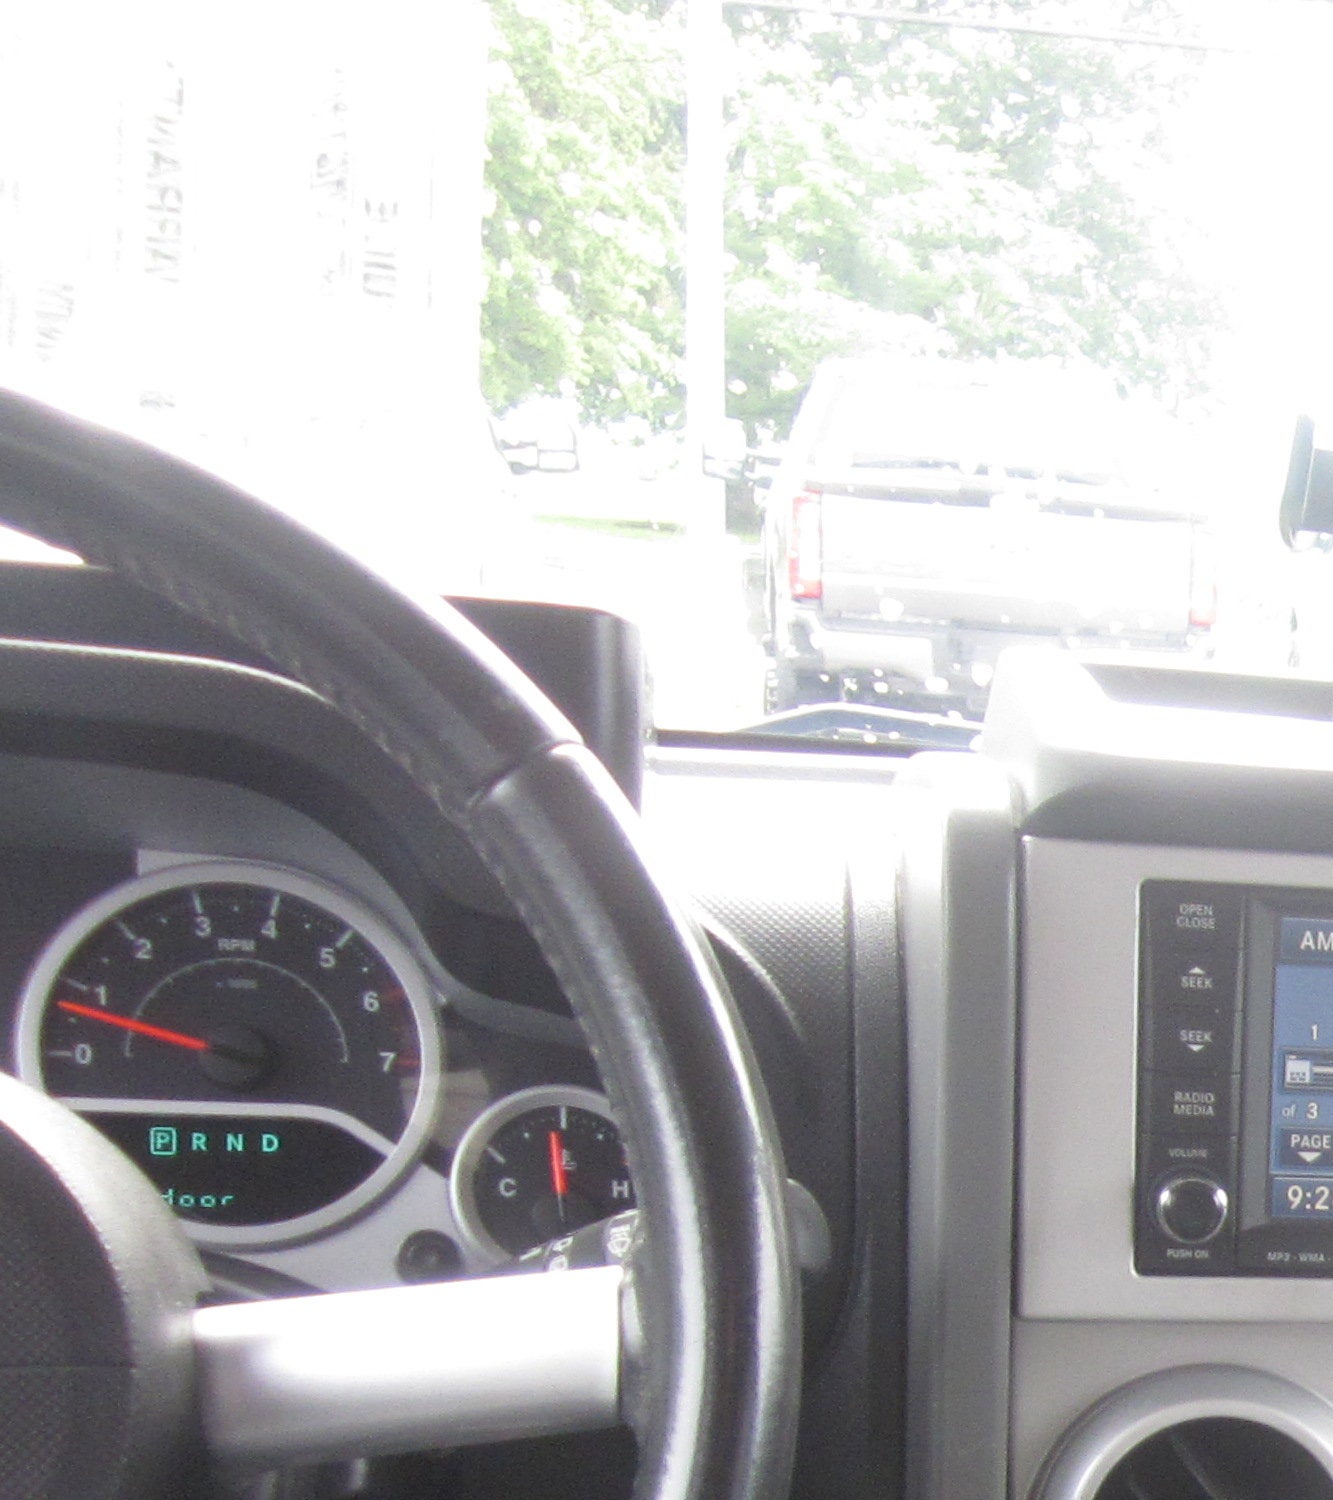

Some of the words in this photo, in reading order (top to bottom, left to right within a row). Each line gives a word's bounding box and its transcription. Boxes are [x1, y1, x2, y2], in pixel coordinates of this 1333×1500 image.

[1179, 903, 1213, 916] OPEN
[195, 916, 211, 937] 3
[261, 919, 277, 938] 4
[1176, 915, 1216, 929] CLOSE
[135, 938, 152, 959] 2
[320, 948, 335, 968] 5
[1181, 976, 1213, 989] SEEK
[96, 985, 106, 1005] 1
[364, 991, 379, 1012] 6
[1180, 1030, 1212, 1043] SEEK
[1311, 1024, 1319, 1040] 1
[75, 1044, 92, 1065] 0
[379, 1051, 396, 1072] 7
[1174, 1091, 1215, 1104] RADIO
[1173, 1104, 1214, 1117] MEDIA
[1282, 1104, 1296, 1118] of
[1306, 1103, 1318, 1119] 3
[156, 1132, 169, 1150] P
[192, 1132, 207, 1151] R
[226, 1133, 243, 1151] N
[262, 1133, 279, 1152] D
[1291, 1134, 1331, 1149] PAGE
[499, 1178, 516, 1197] C
[612, 1180, 628, 1198] H
[1267, 1252, 1290, 1262] MP3
[1299, 1252, 1325, 1263] WMA
